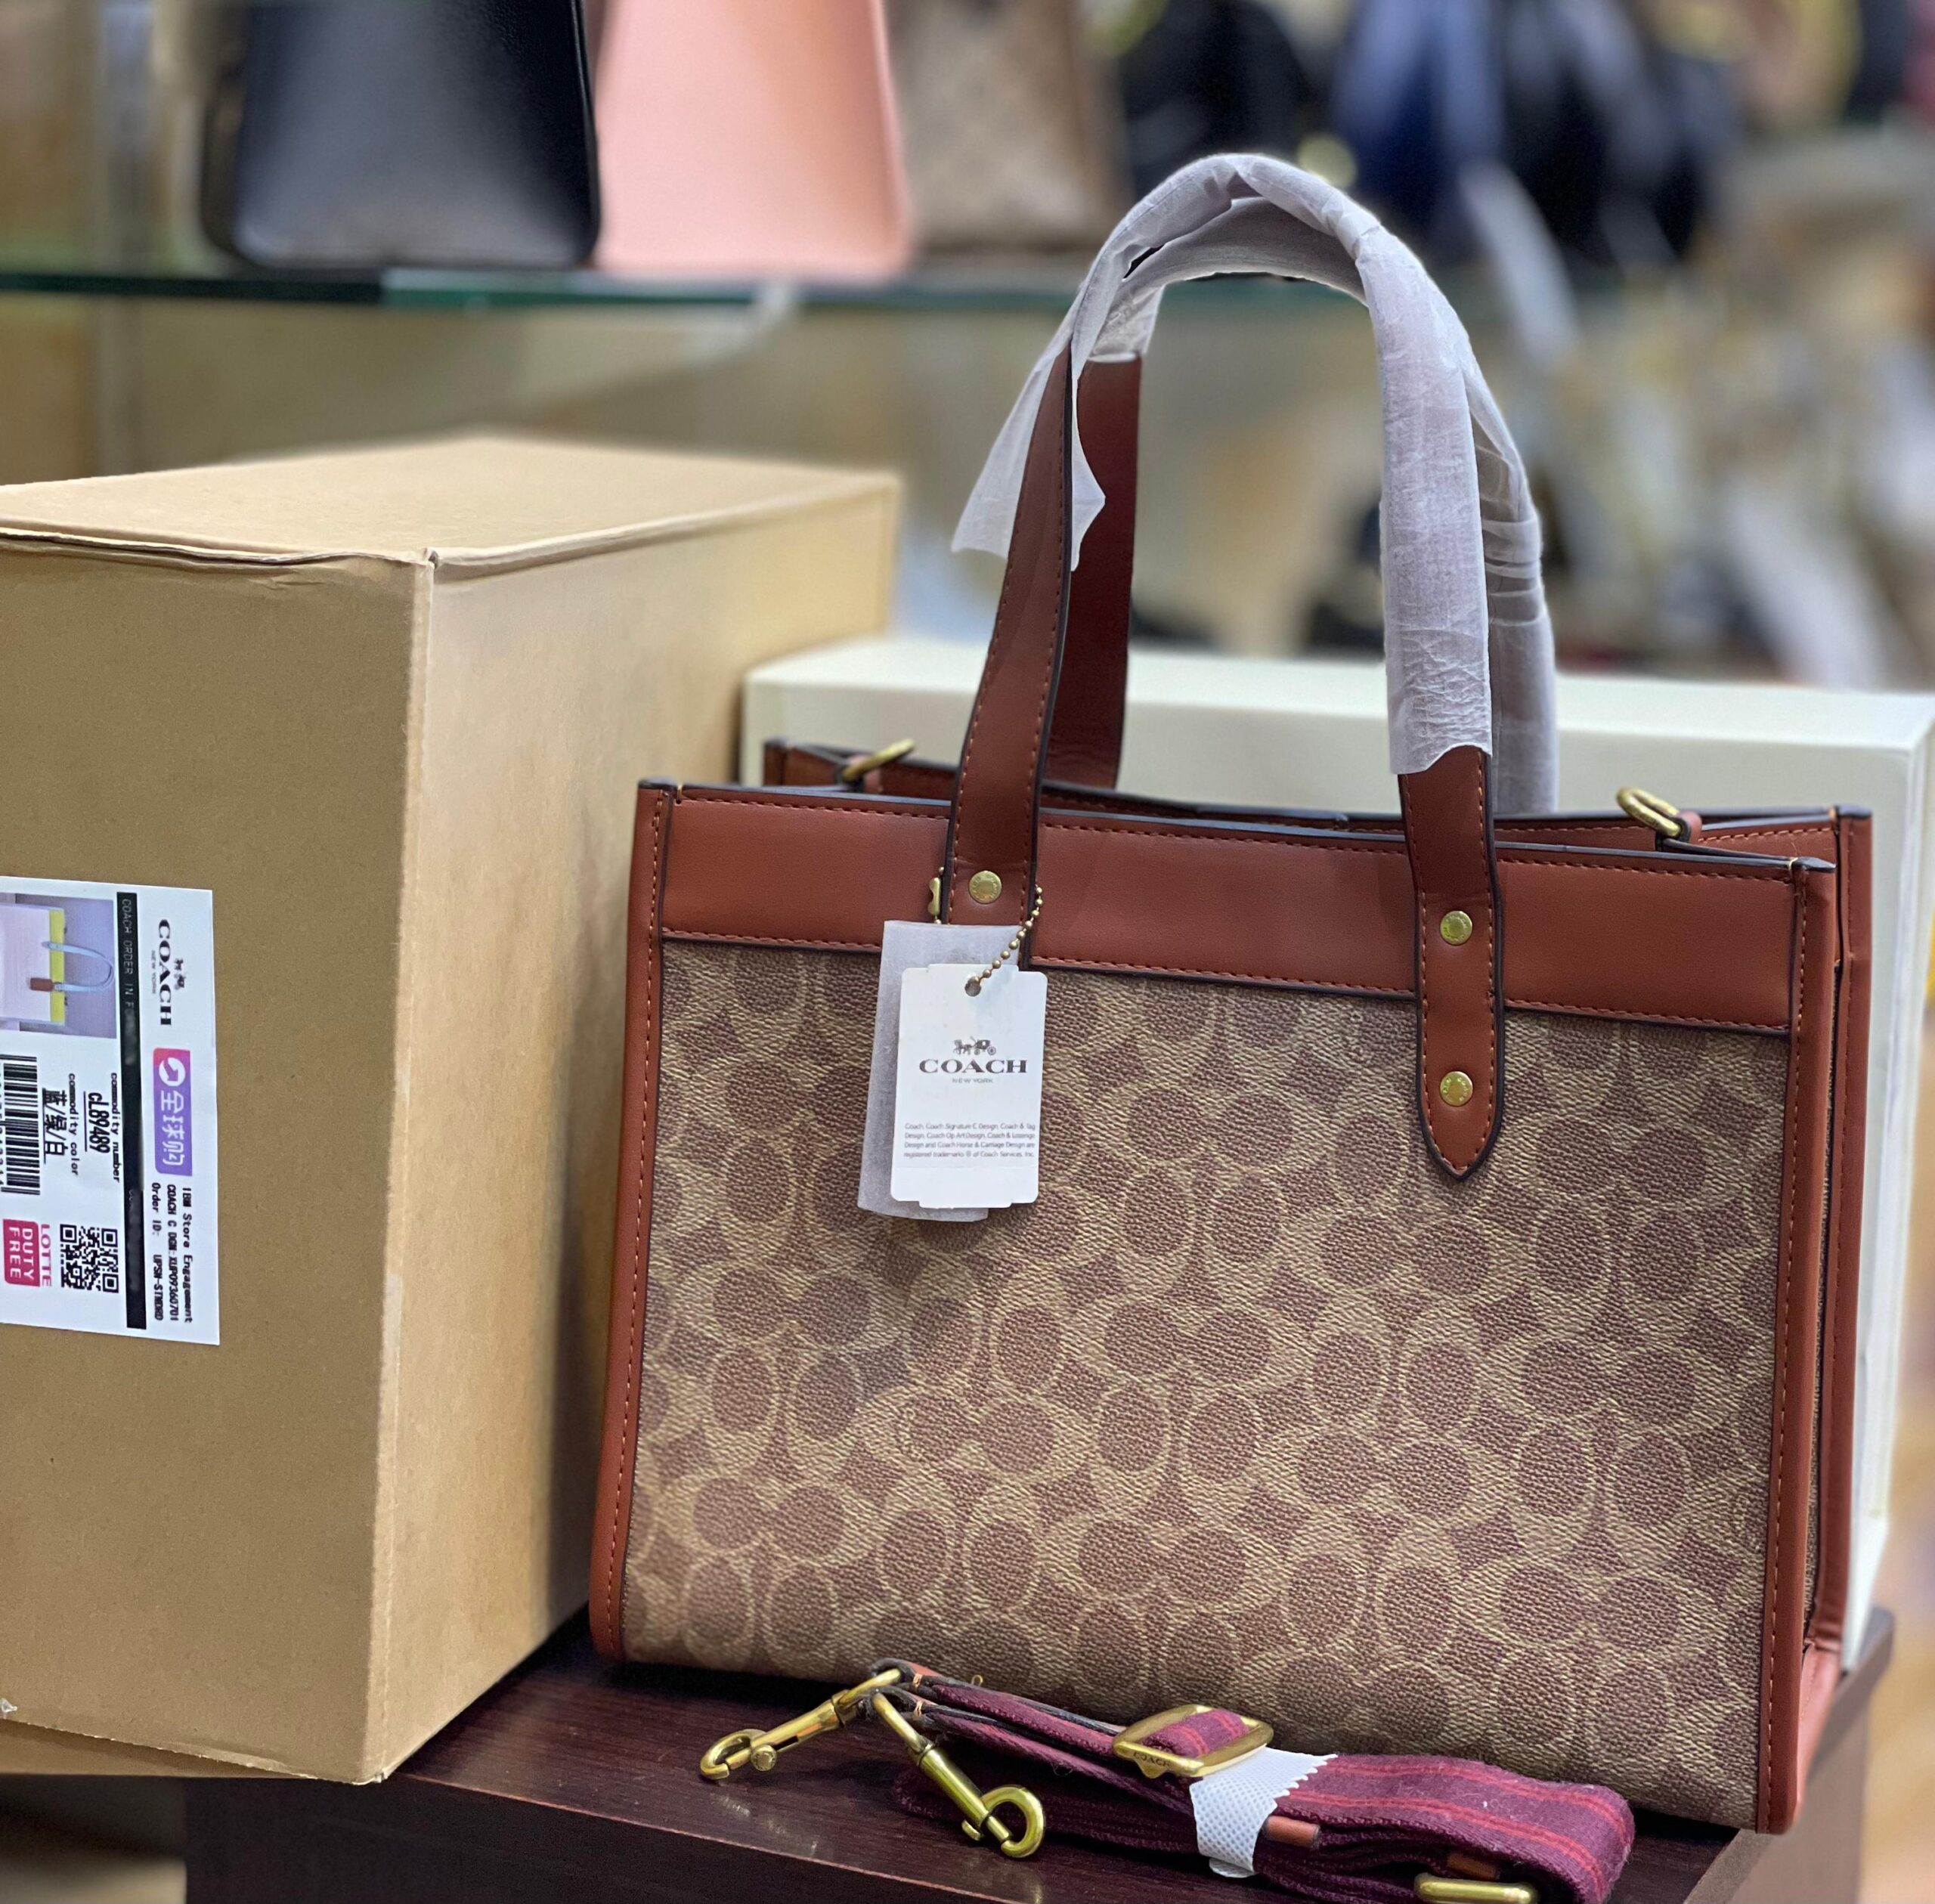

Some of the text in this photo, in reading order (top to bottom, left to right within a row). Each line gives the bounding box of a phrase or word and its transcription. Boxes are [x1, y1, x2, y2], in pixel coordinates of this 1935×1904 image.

[122, 899, 132, 933] COACH
[124, 940, 133, 974] ORDER
[159, 919, 172, 1026] COACH
[919, 1059, 1027, 1073] COACH
[45, 1090, 67, 1155] 蓝/绿/白
[69, 1073, 80, 1175] commodity color
[88, 1092, 110, 1153] cL89489
[110, 1073, 122, 1182] commodity number
[159, 1090, 184, 1166] 全球购
[151, 1183, 161, 1212] Order
[167, 1184, 177, 1215] COACH
[9, 1227, 20, 1277] FREE
[23, 1228, 33, 1280] DUTY
[41, 1224, 51, 1286] LOTTE
[183, 1213, 192, 1248] Store
[184, 1255, 193, 1323] Engagement
[1133, 1751, 1169, 1767] COACH
